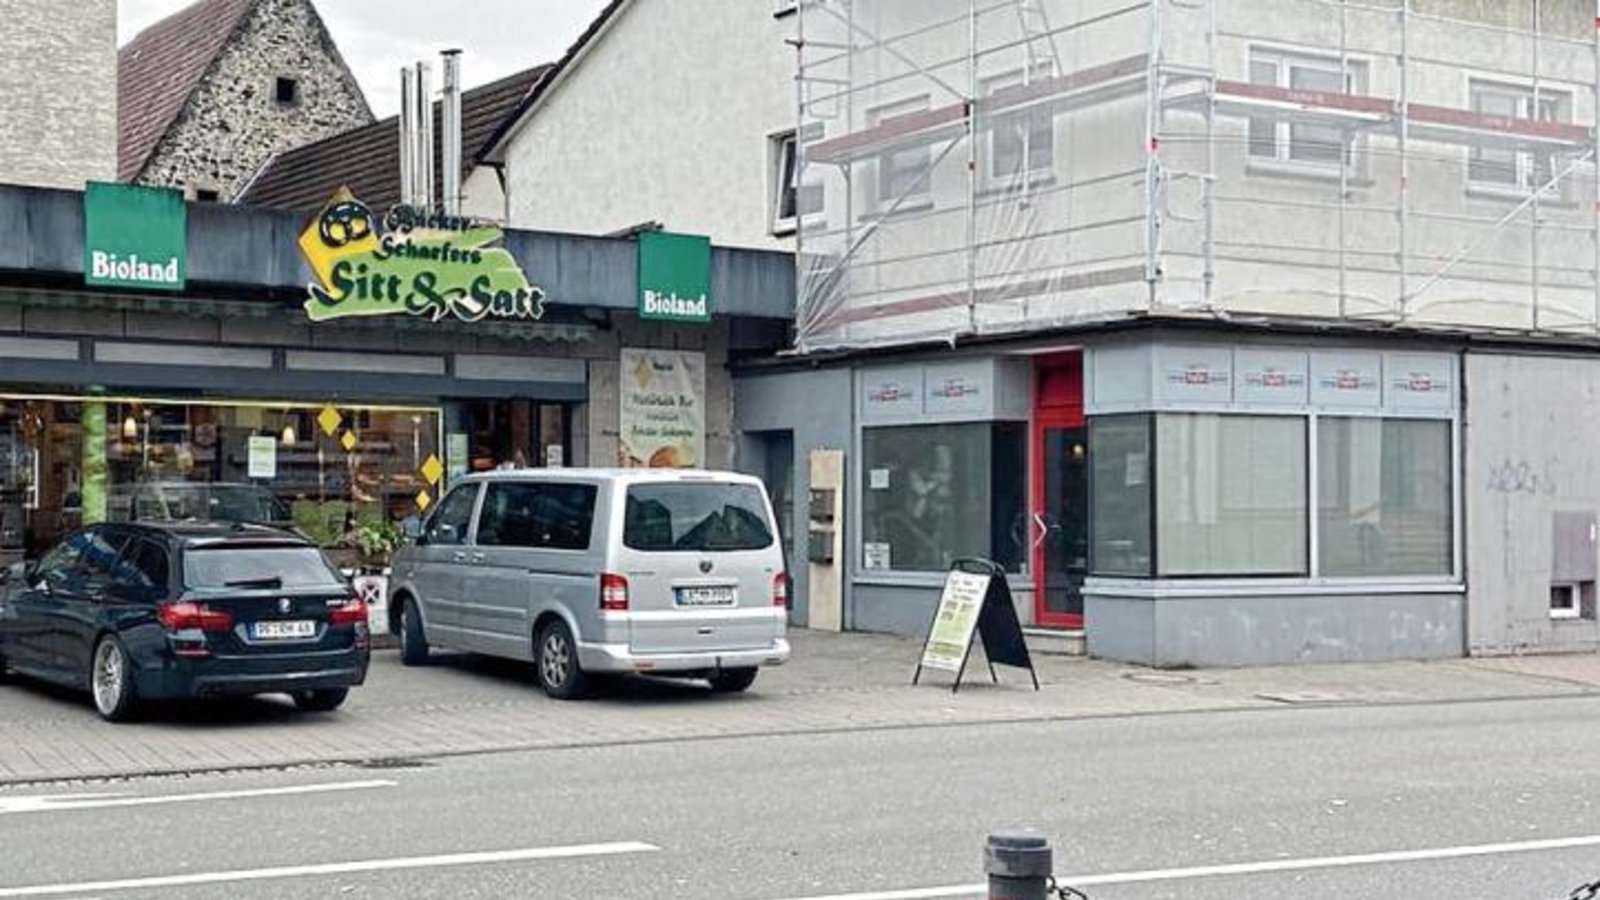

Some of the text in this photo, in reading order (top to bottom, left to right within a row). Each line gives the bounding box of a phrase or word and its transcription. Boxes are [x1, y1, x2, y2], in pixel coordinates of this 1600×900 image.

[373, 236, 482, 264] Schaefers
[92, 249, 179, 282] Bioland
[311, 260, 543, 318] Sitt & Satt
[643, 290, 706, 315] Bioland
